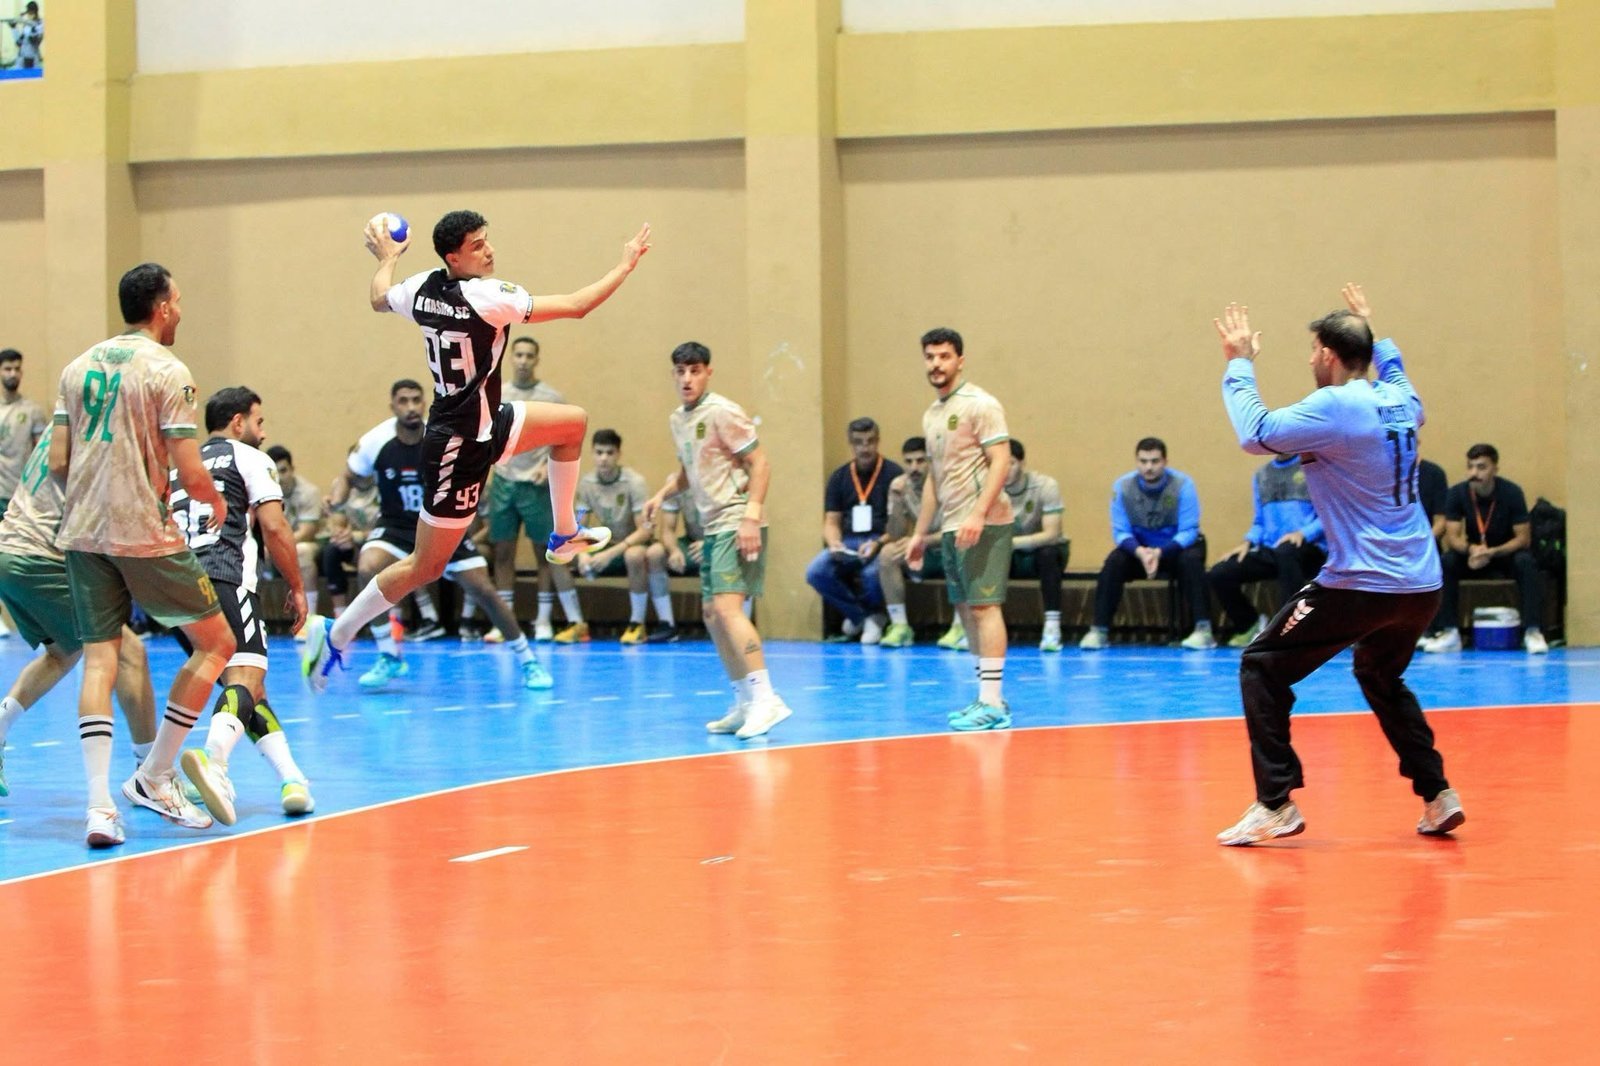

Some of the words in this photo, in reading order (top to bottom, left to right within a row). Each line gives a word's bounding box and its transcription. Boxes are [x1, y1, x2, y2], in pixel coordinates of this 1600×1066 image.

[454, 305, 470, 320] SC
[420, 325, 477, 397] 93
[398, 485, 424, 512] 18
[455, 482, 481, 510] 93
